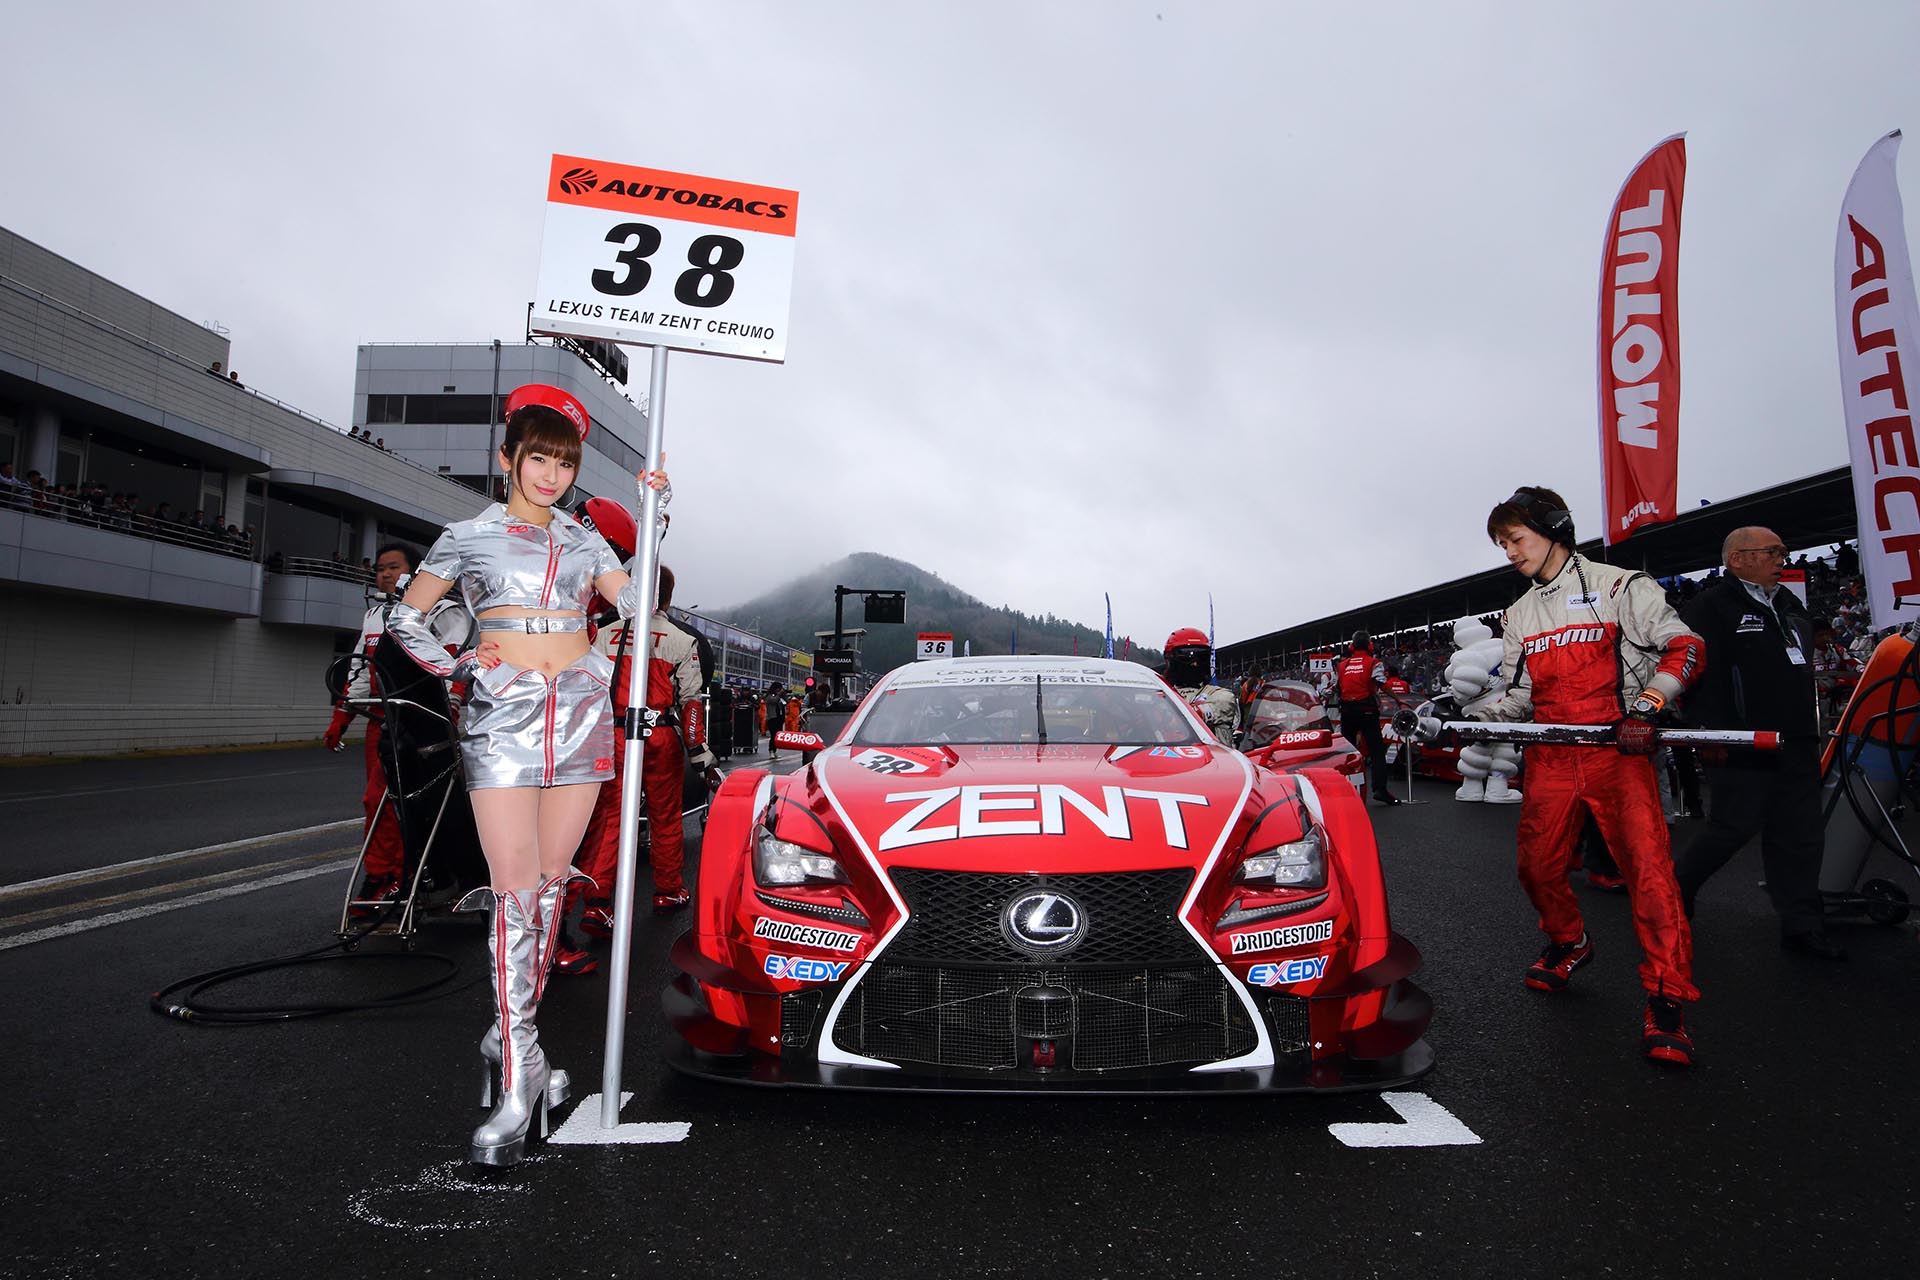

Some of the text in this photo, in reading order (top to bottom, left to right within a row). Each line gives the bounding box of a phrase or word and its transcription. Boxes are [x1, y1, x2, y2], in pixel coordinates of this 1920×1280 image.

[599, 178, 788, 219] AUTOBACS
[591, 222, 745, 308] 38
[548, 299, 775, 340] LEXUS TEAM ZENT CERUMO
[1611, 189, 1665, 450] MOTUL
[1848, 213, 1920, 598] AUTECH
[1621, 501, 1660, 530] MOTUL
[609, 628, 668, 648] ZET
[924, 641, 946, 654] 36
[1524, 627, 1604, 656] cerumo
[1314, 660, 1327, 669] 15
[777, 732, 816, 745] EBBRO
[1280, 731, 1320, 744] EBBRO
[878, 784, 1210, 851] ZENT
[755, 918, 860, 950] BRIDGESTONE
[1232, 921, 1331, 952] BRIDGESTONE
[765, 956, 847, 980] EXEDY
[1248, 957, 1328, 985] EXEDY
